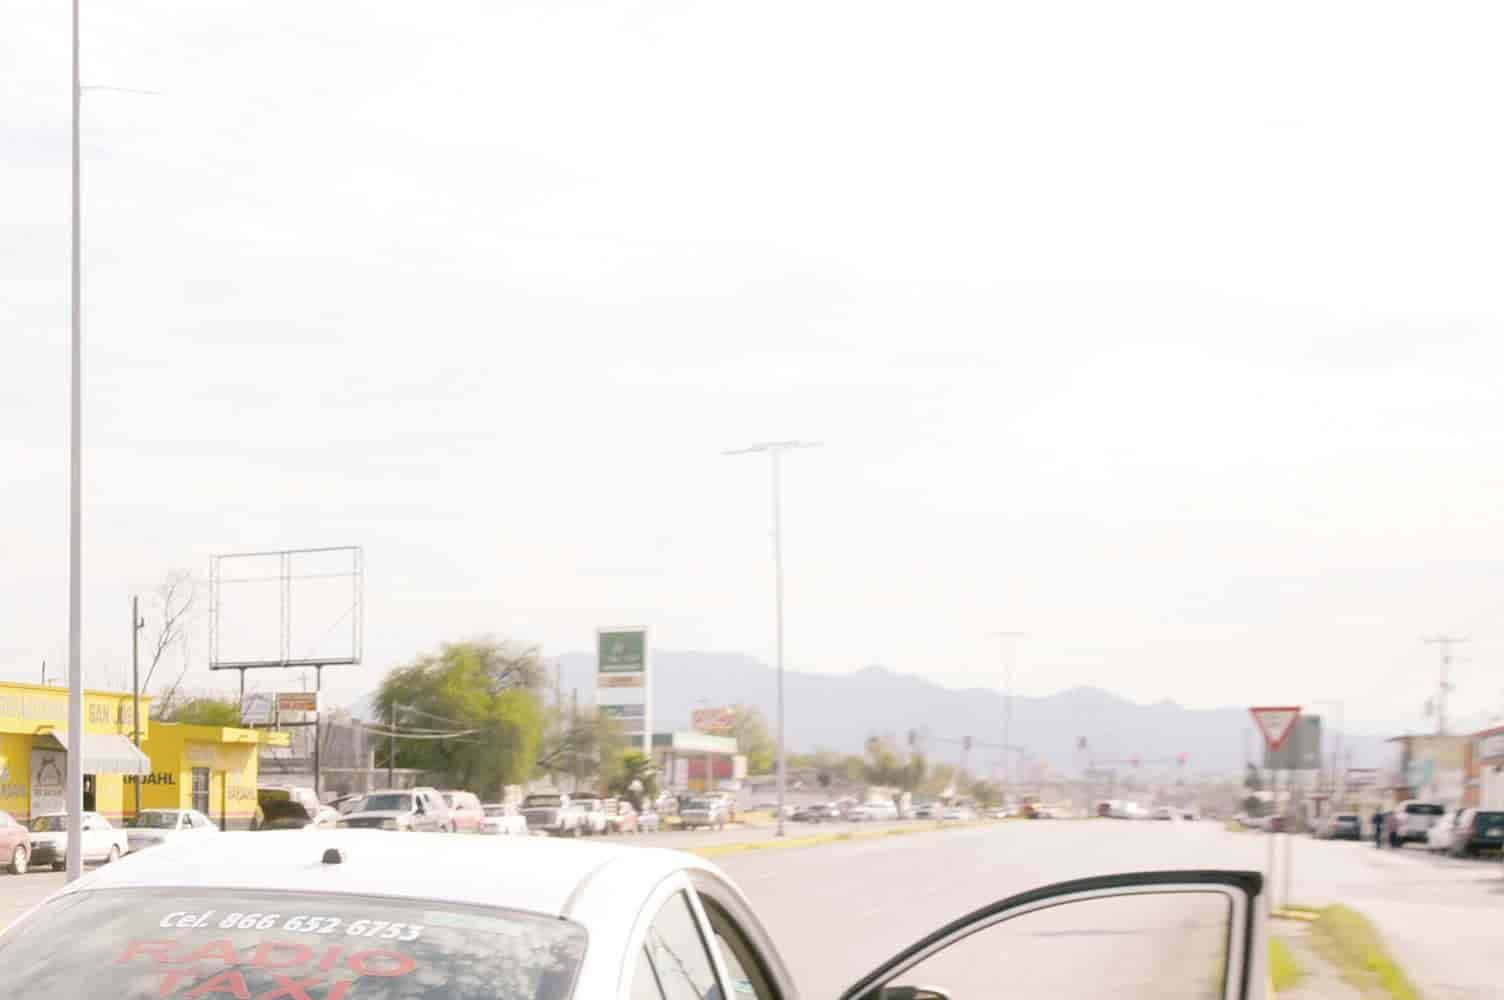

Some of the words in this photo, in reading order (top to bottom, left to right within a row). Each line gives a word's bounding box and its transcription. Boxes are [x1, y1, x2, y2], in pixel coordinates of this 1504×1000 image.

[158, 910, 216, 929] Cel.
[219, 912, 281, 930] 866
[282, 915, 342, 934] 652
[345, 919, 425, 942] 6753
[112, 937, 417, 978] RADIO
